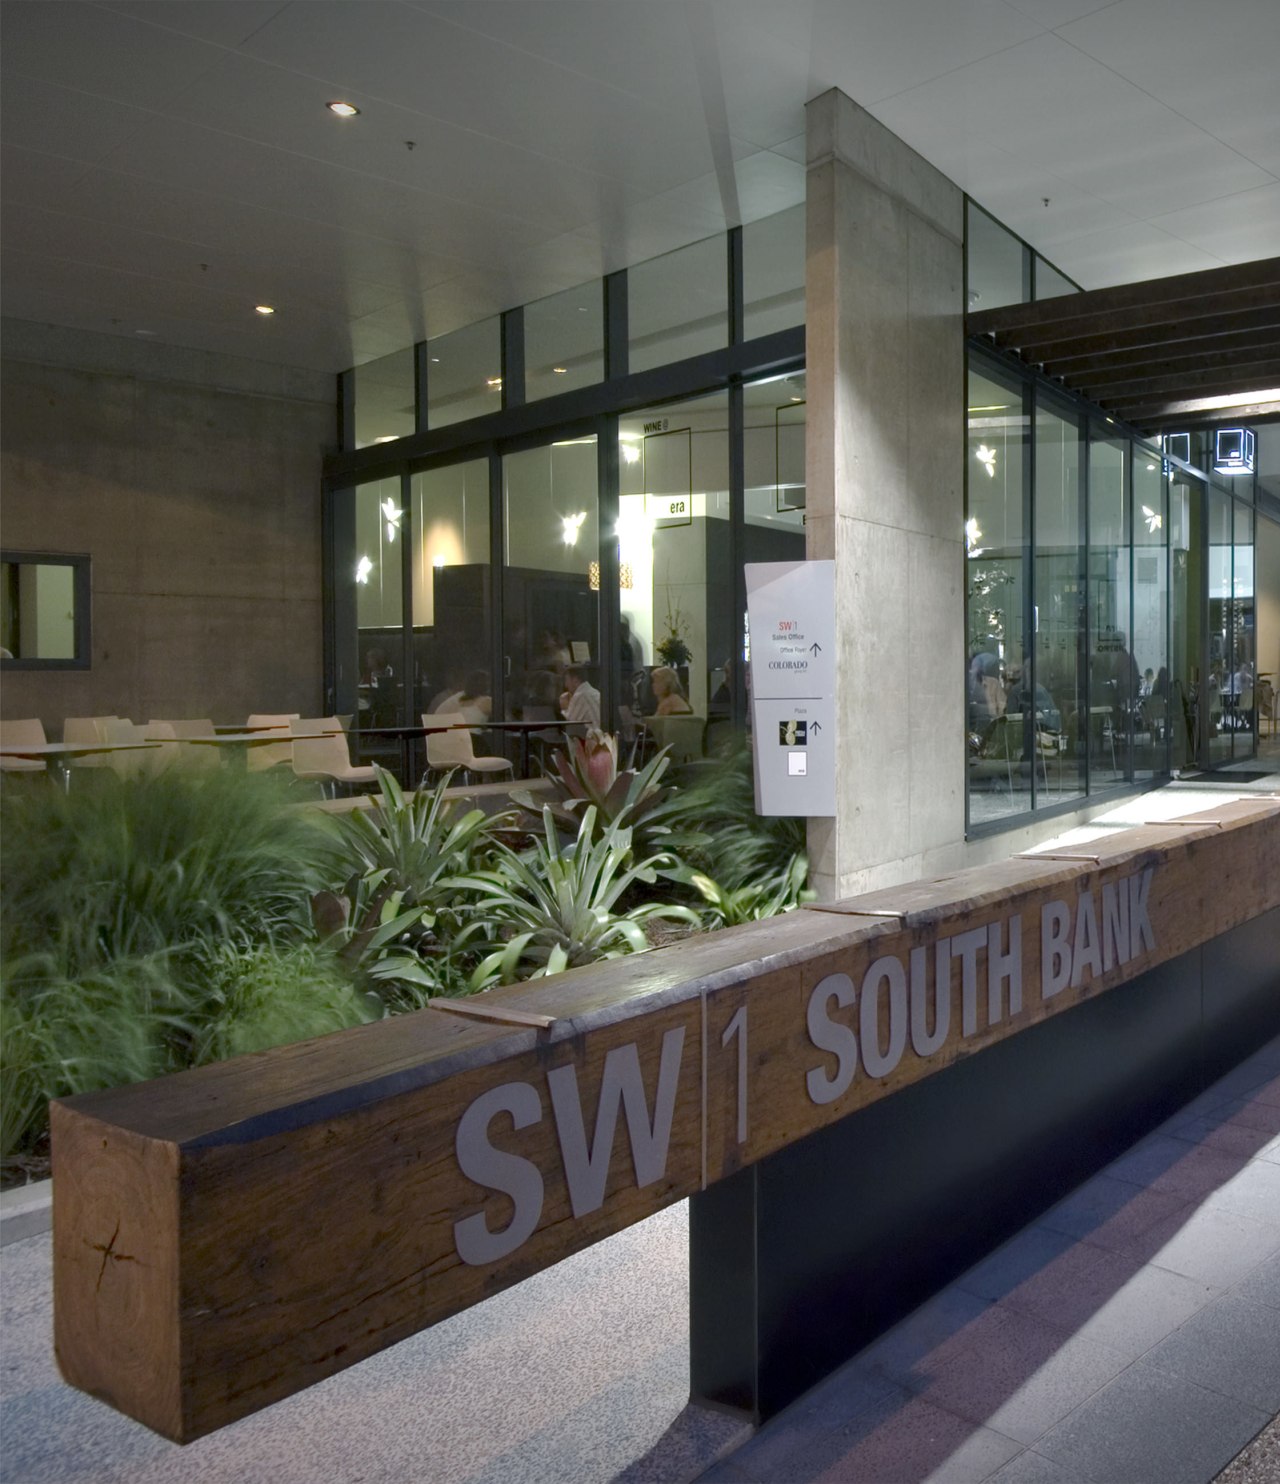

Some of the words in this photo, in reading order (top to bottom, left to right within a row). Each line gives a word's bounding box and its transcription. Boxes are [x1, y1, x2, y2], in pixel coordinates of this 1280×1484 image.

[644, 421, 661, 433] WINE
[670, 501, 685, 514] era
[768, 660, 808, 670] COLORADO
[805, 915, 1023, 1106] SOUTH
[1041, 868, 1158, 1001] BANK
